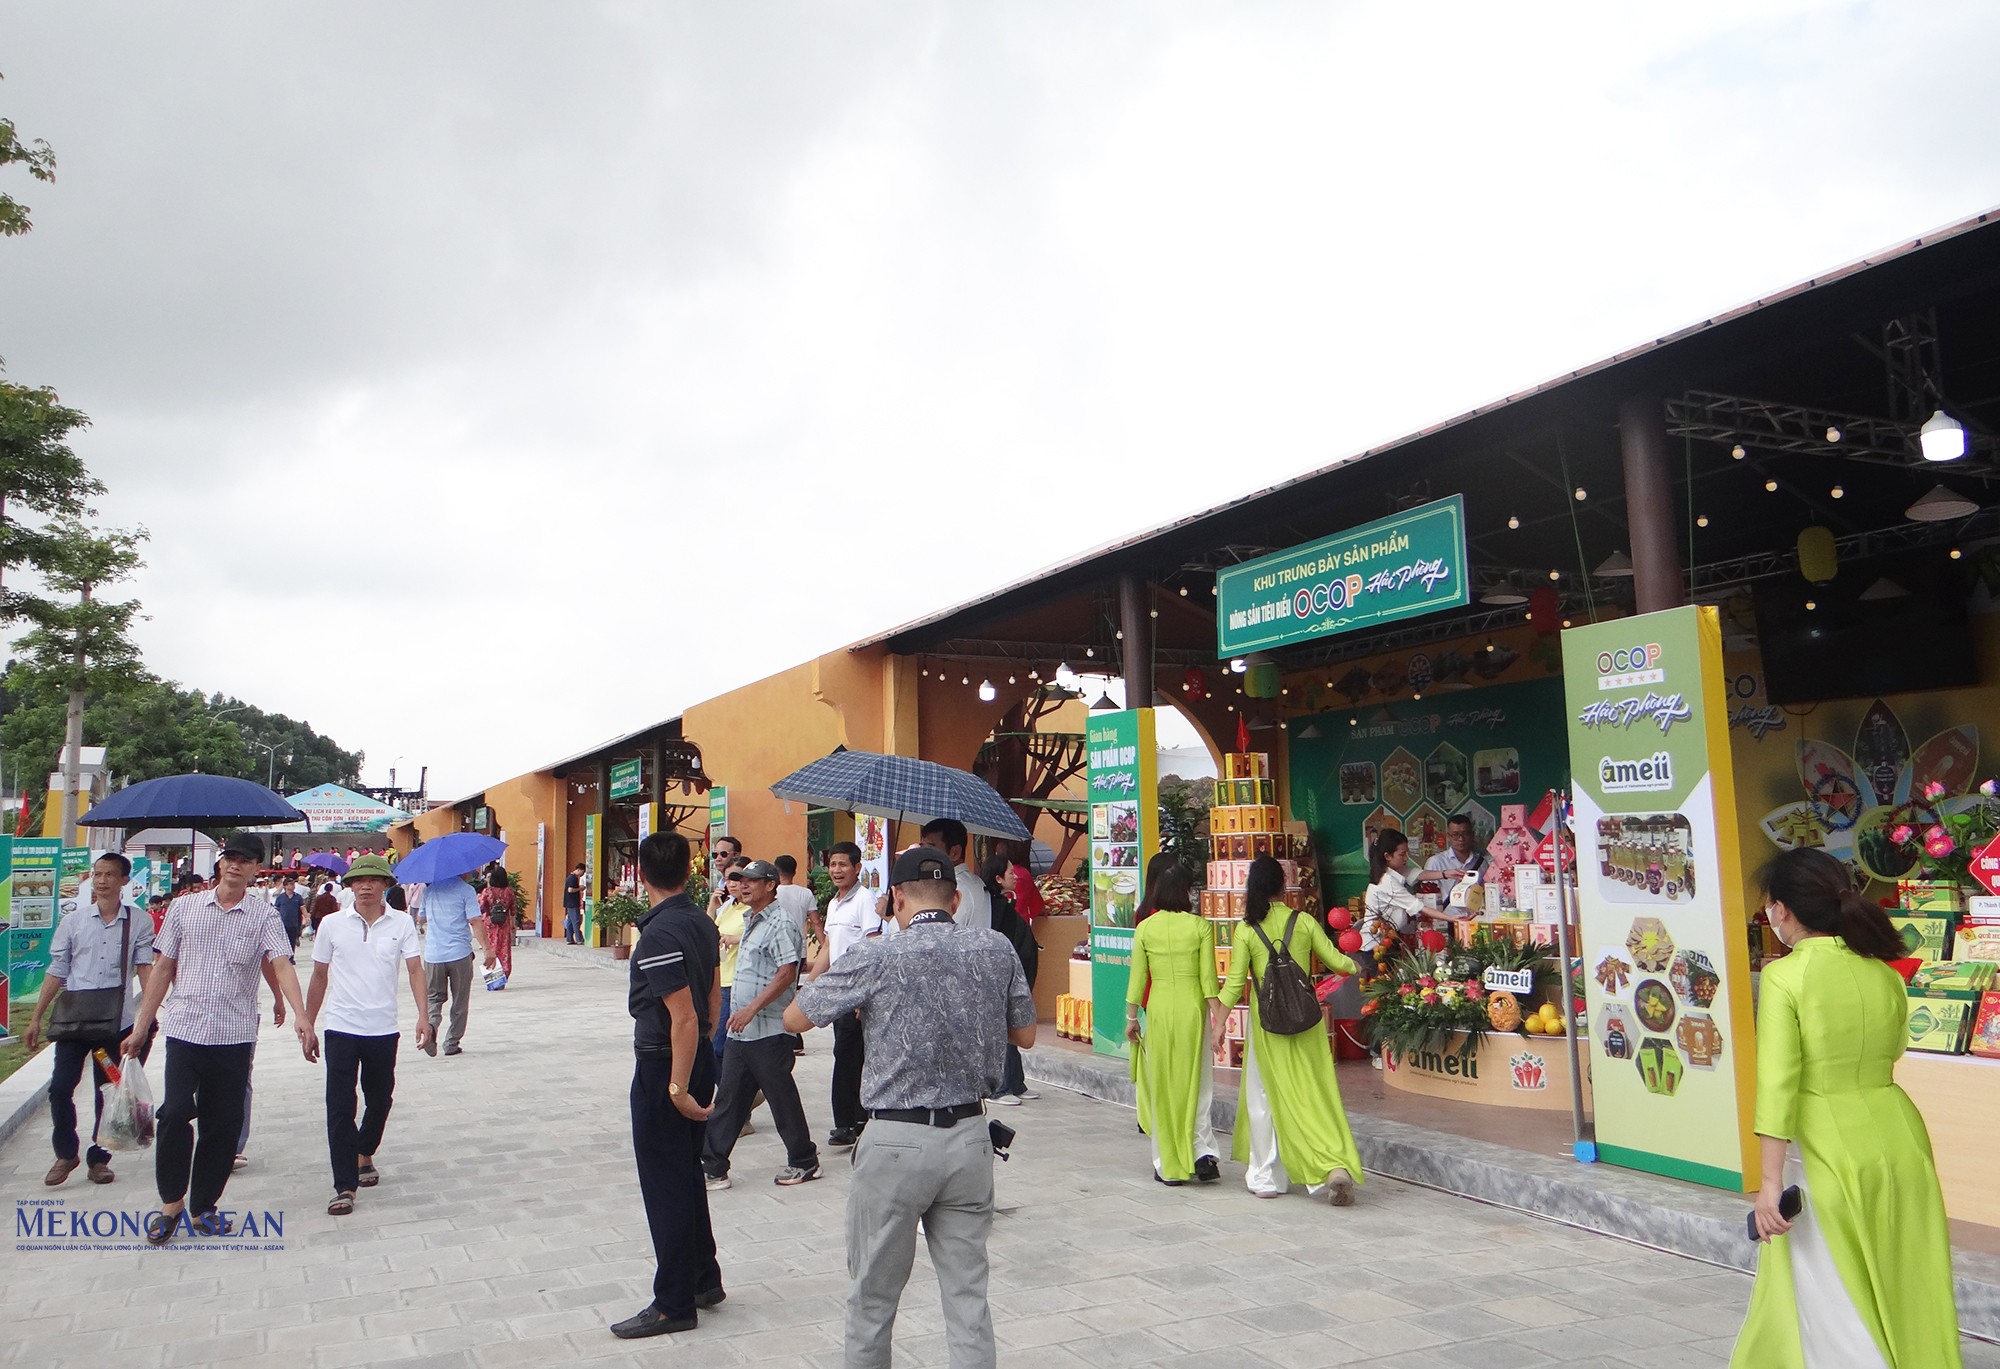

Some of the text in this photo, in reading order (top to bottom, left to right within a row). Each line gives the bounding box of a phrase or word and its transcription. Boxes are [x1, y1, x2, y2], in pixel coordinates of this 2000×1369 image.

[1253, 530, 1409, 592] KHU TRƯNG BÀY SẢN PHẨM
[1247, 602, 1261, 626] SẢN
[1261, 600, 1275, 623] TIÊU
[1275, 592, 1291, 619] BIỂU
[1293, 573, 1363, 619] OCOP
[1365, 568, 1396, 594] Hải
[1394, 557, 1449, 594] Phòng
[1596, 642, 1662, 675] OCOP
[1578, 690, 1692, 735] Hải Phòng
[909, 911, 938, 924] ONY
